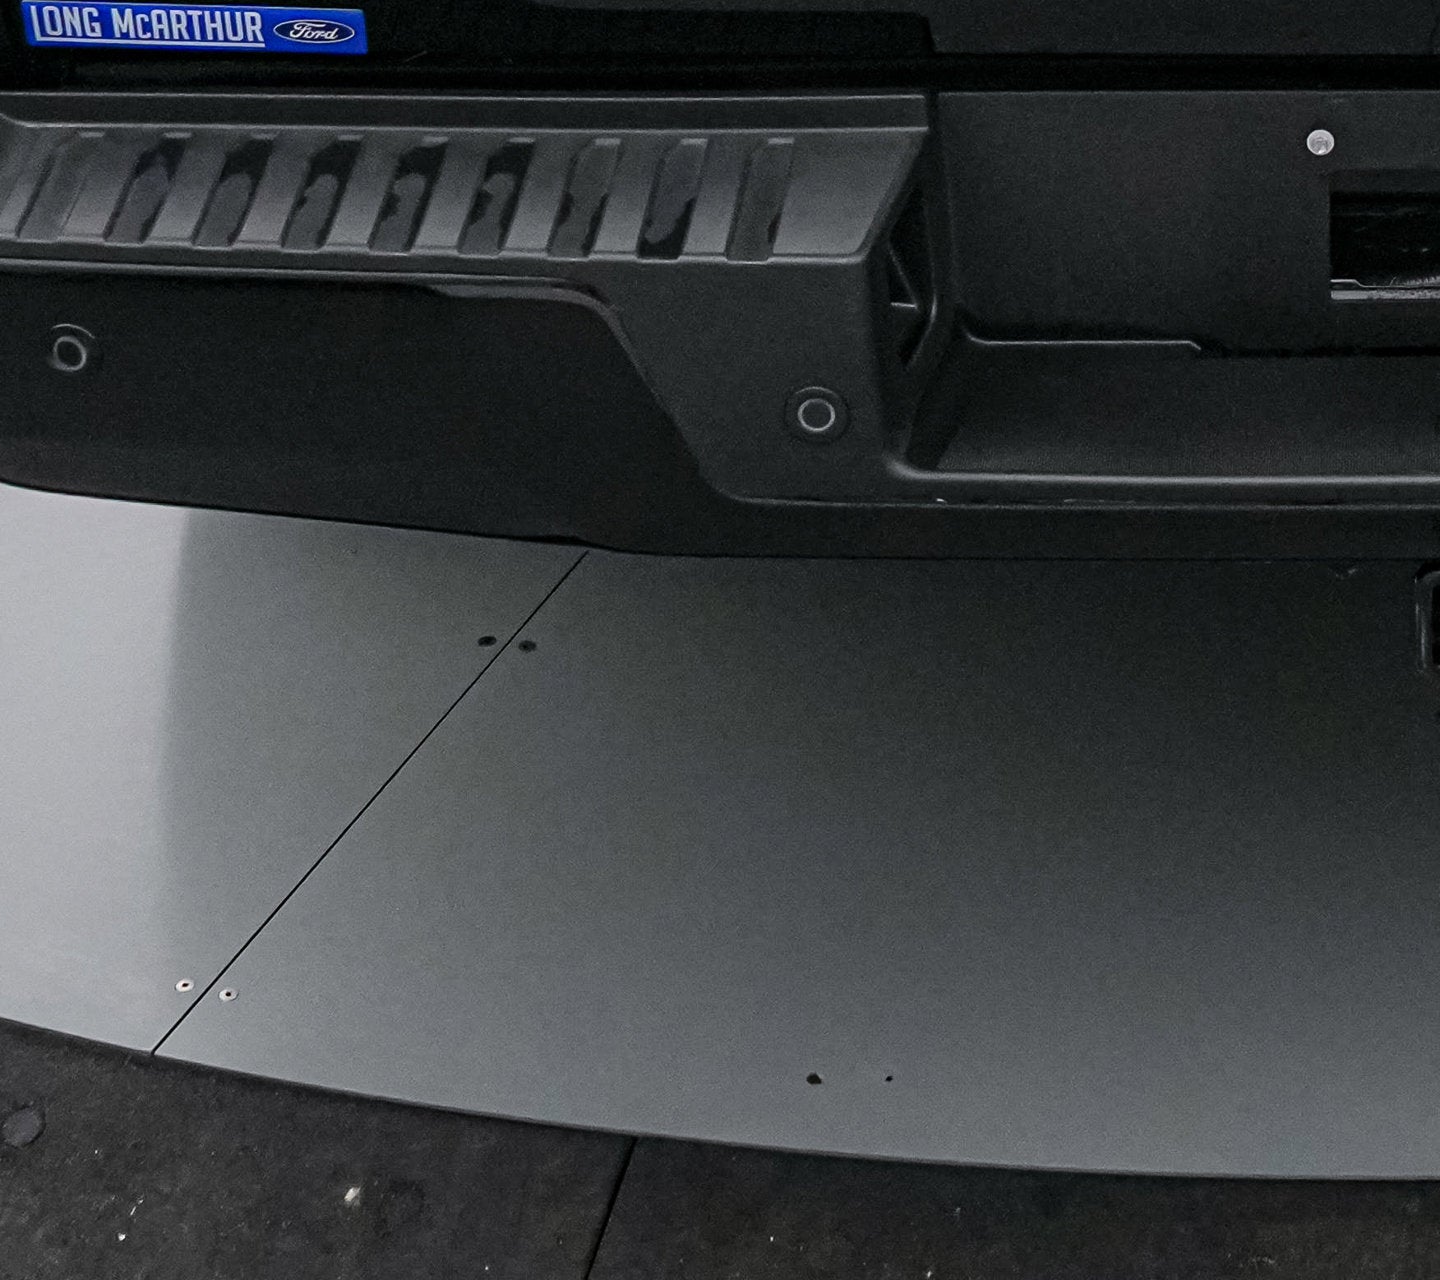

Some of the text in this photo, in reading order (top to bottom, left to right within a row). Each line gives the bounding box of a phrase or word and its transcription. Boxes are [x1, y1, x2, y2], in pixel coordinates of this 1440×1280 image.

[30, 5, 340, 43] LONG McARTHUR Ford
